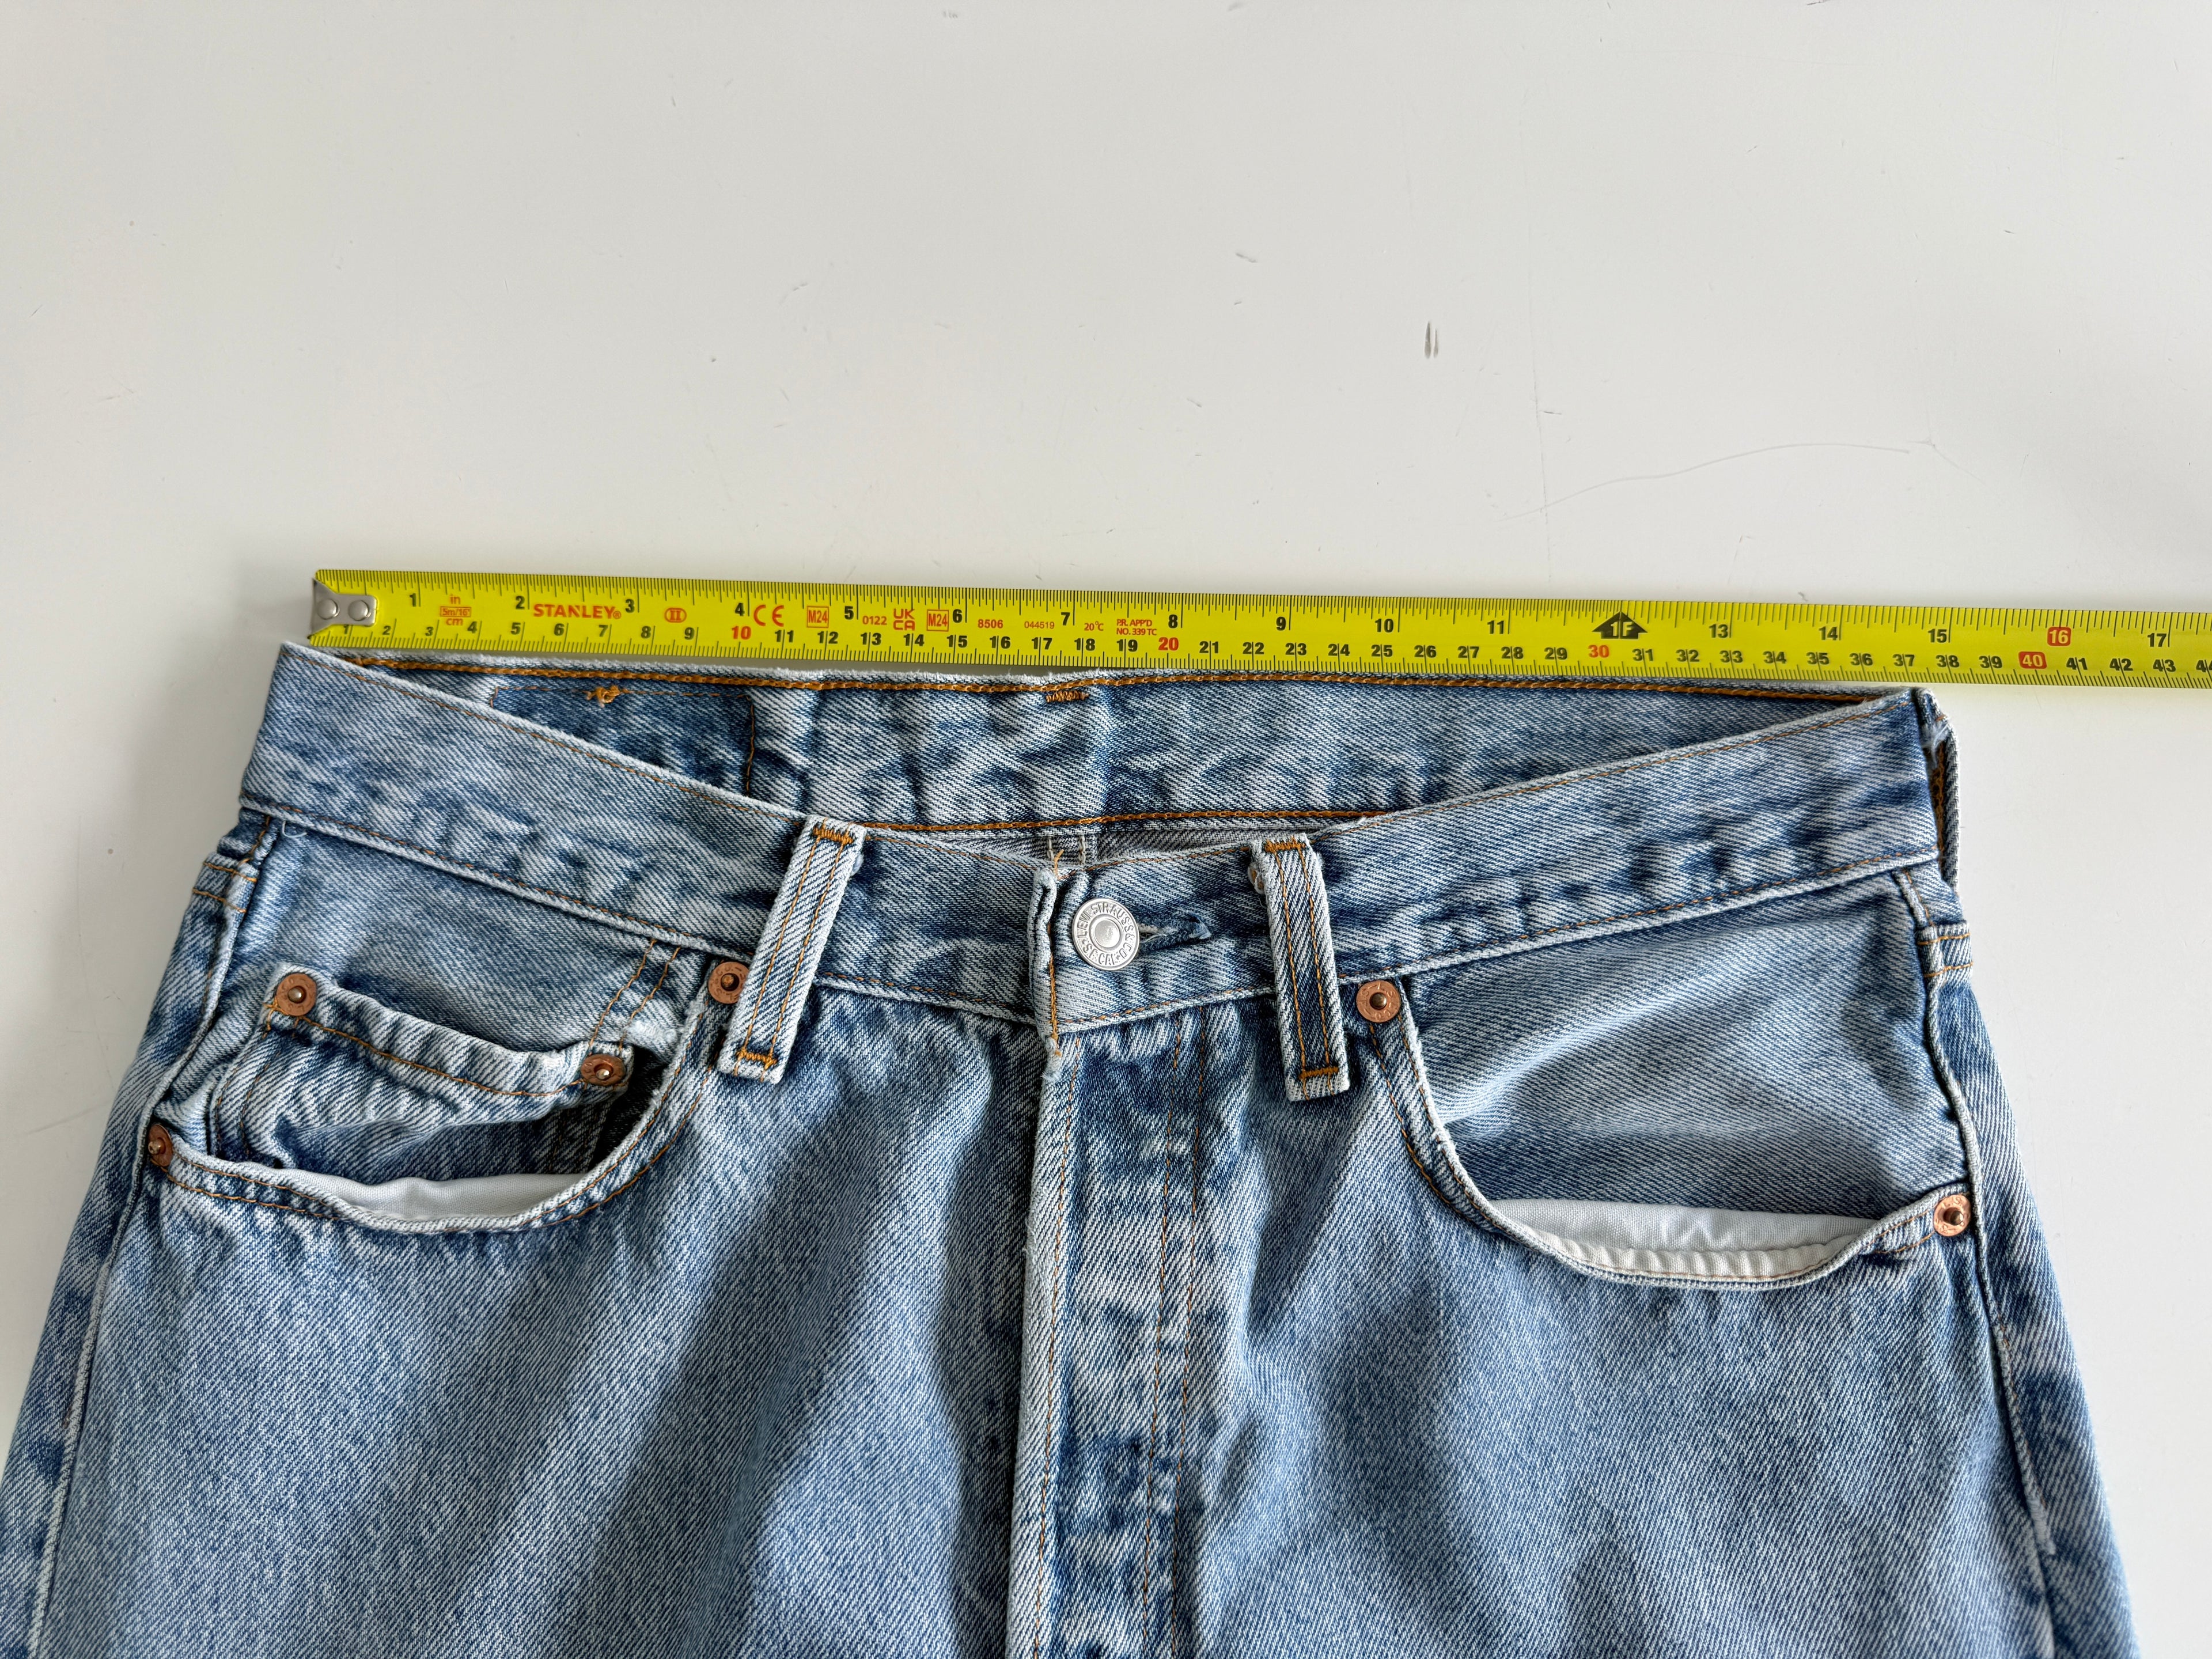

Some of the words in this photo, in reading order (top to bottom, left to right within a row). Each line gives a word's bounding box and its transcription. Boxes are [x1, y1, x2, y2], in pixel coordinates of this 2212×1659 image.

[410, 594, 416, 607] 1
[450, 593, 460, 604] in
[516, 596, 525, 609] 2
[625, 599, 635, 613] 3
[734, 603, 745, 616] 4
[808, 610, 828, 623] M24
[844, 606, 854, 620] 5
[893, 608, 915, 619] UK
[952, 609, 963, 623] 6
[1061, 612, 1070, 626] 7
[862, 616, 887, 625] 0122
[893, 620, 915, 630] CA
[929, 613, 948, 627] M24
[978, 619, 1003, 628] 8506
[1168, 614, 1178, 628] 8
[1276, 617, 1286, 631] 9
[1374, 619, 1394, 632] 10
[382, 626, 391, 635] 2
[426, 626, 434, 637] 3
[467, 622, 478, 634] 4
[511, 623, 521, 635] 5
[554, 624, 565, 636] 6
[599, 625, 608, 637] 7
[641, 626, 651, 639] 8
[684, 627, 695, 640] 9
[732, 626, 751, 640] 10
[1487, 620, 1504, 634] 11
[1611, 622, 1633, 636] 1F
[1709, 624, 1728, 638] 13
[775, 629, 794, 642] 11
[817, 631, 839, 644] 12
[861, 632, 882, 646] 13
[903, 634, 924, 646] 14
[1819, 627, 1838, 641] 14
[1928, 629, 1947, 643] 15
[2050, 630, 2069, 643] 16
[2147, 633, 2166, 647] 17
[947, 635, 967, 648] 15
[990, 636, 1010, 649] 16
[1032, 637, 1052, 650] 17
[1074, 638, 1095, 651] 18
[1116, 639, 1138, 652] 19
[1158, 637, 1179, 651] 20
[1199, 640, 1219, 653] 21
[1243, 642, 1264, 655] 22
[1285, 643, 1306, 656] 23
[1328, 644, 1350, 657] 24
[1371, 645, 1393, 657] 25
[1414, 645, 1437, 658] 26
[1457, 646, 1479, 658] 27
[1501, 646, 1524, 660] 28
[1544, 647, 1567, 660] 29
[1588, 645, 1609, 658] 30
[1633, 649, 1653, 661] 31
[1676, 650, 1699, 662] 32
[1719, 650, 1743, 663] 33
[1763, 651, 1786, 664] 34
[1807, 652, 1829, 665] 35
[1850, 653, 1873, 666] 36
[1893, 654, 1915, 666] 37
[1936, 655, 1959, 668] 38
[1979, 656, 2002, 668] 39
[2022, 654, 2043, 666] 40
[2066, 657, 2088, 671] 41
[2109, 658, 2133, 671] 42
[2153, 659, 2176, 672] 43
